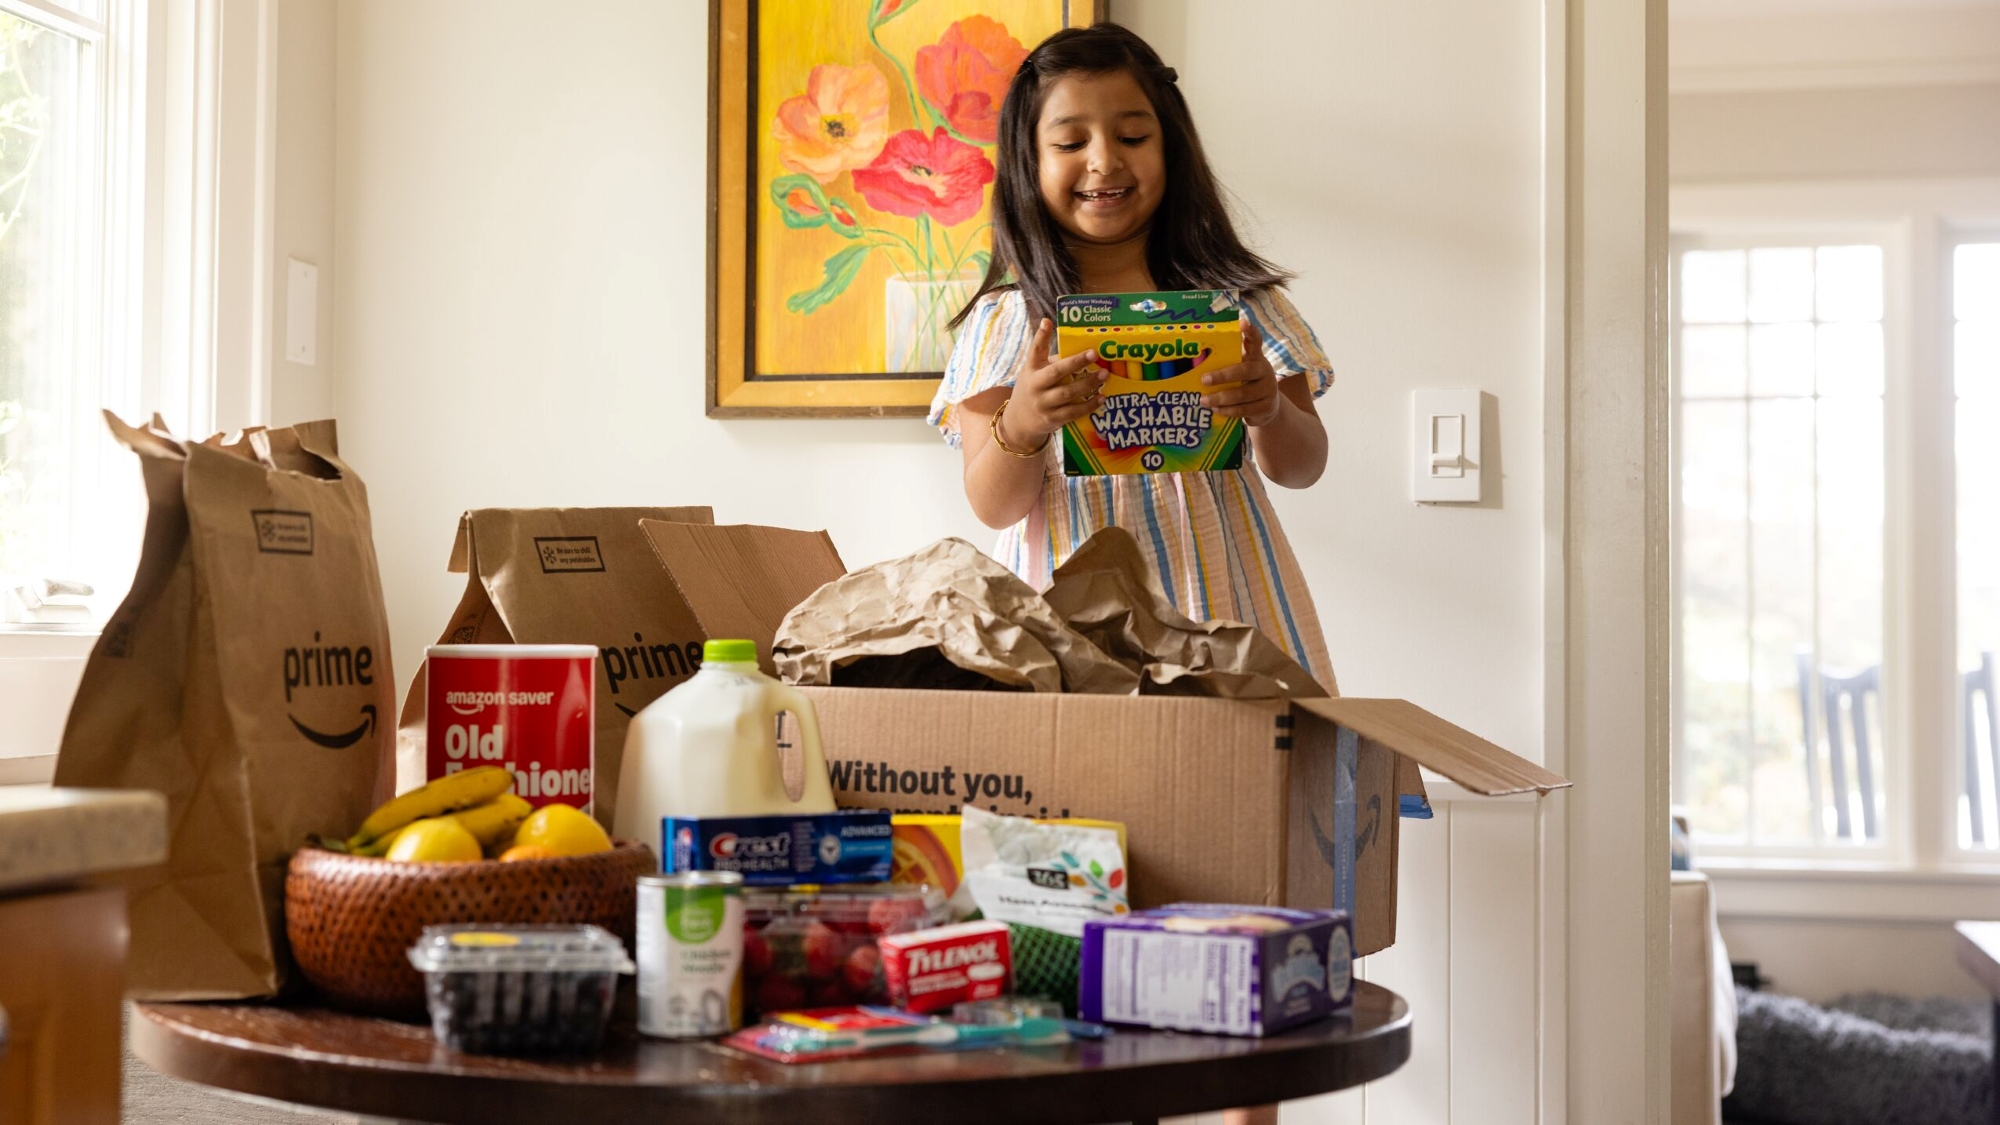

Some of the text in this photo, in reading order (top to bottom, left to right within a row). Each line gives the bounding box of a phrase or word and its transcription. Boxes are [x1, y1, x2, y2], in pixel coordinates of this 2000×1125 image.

[1060, 306, 1082, 323] 10
[1083, 305, 1112, 314] Classic
[1083, 314, 1111, 322] Colors
[1100, 338, 1199, 361] Crayola
[1105, 392, 1200, 410] ULTRA-CLEAN
[1092, 406, 1212, 432] WASHABLE
[1108, 427, 1200, 450] MARKERS
[1143, 453, 1162, 468] 10
[284, 631, 374, 703] prime
[601, 632, 704, 694] prime
[446, 691, 555, 705] amazon saver
[445, 724, 504, 760] Old
[445, 761, 592, 798] hione
[827, 760, 1033, 804] Without you,
[709, 832, 791, 860] Crest
[904, 940, 999, 977] TYLENOL
